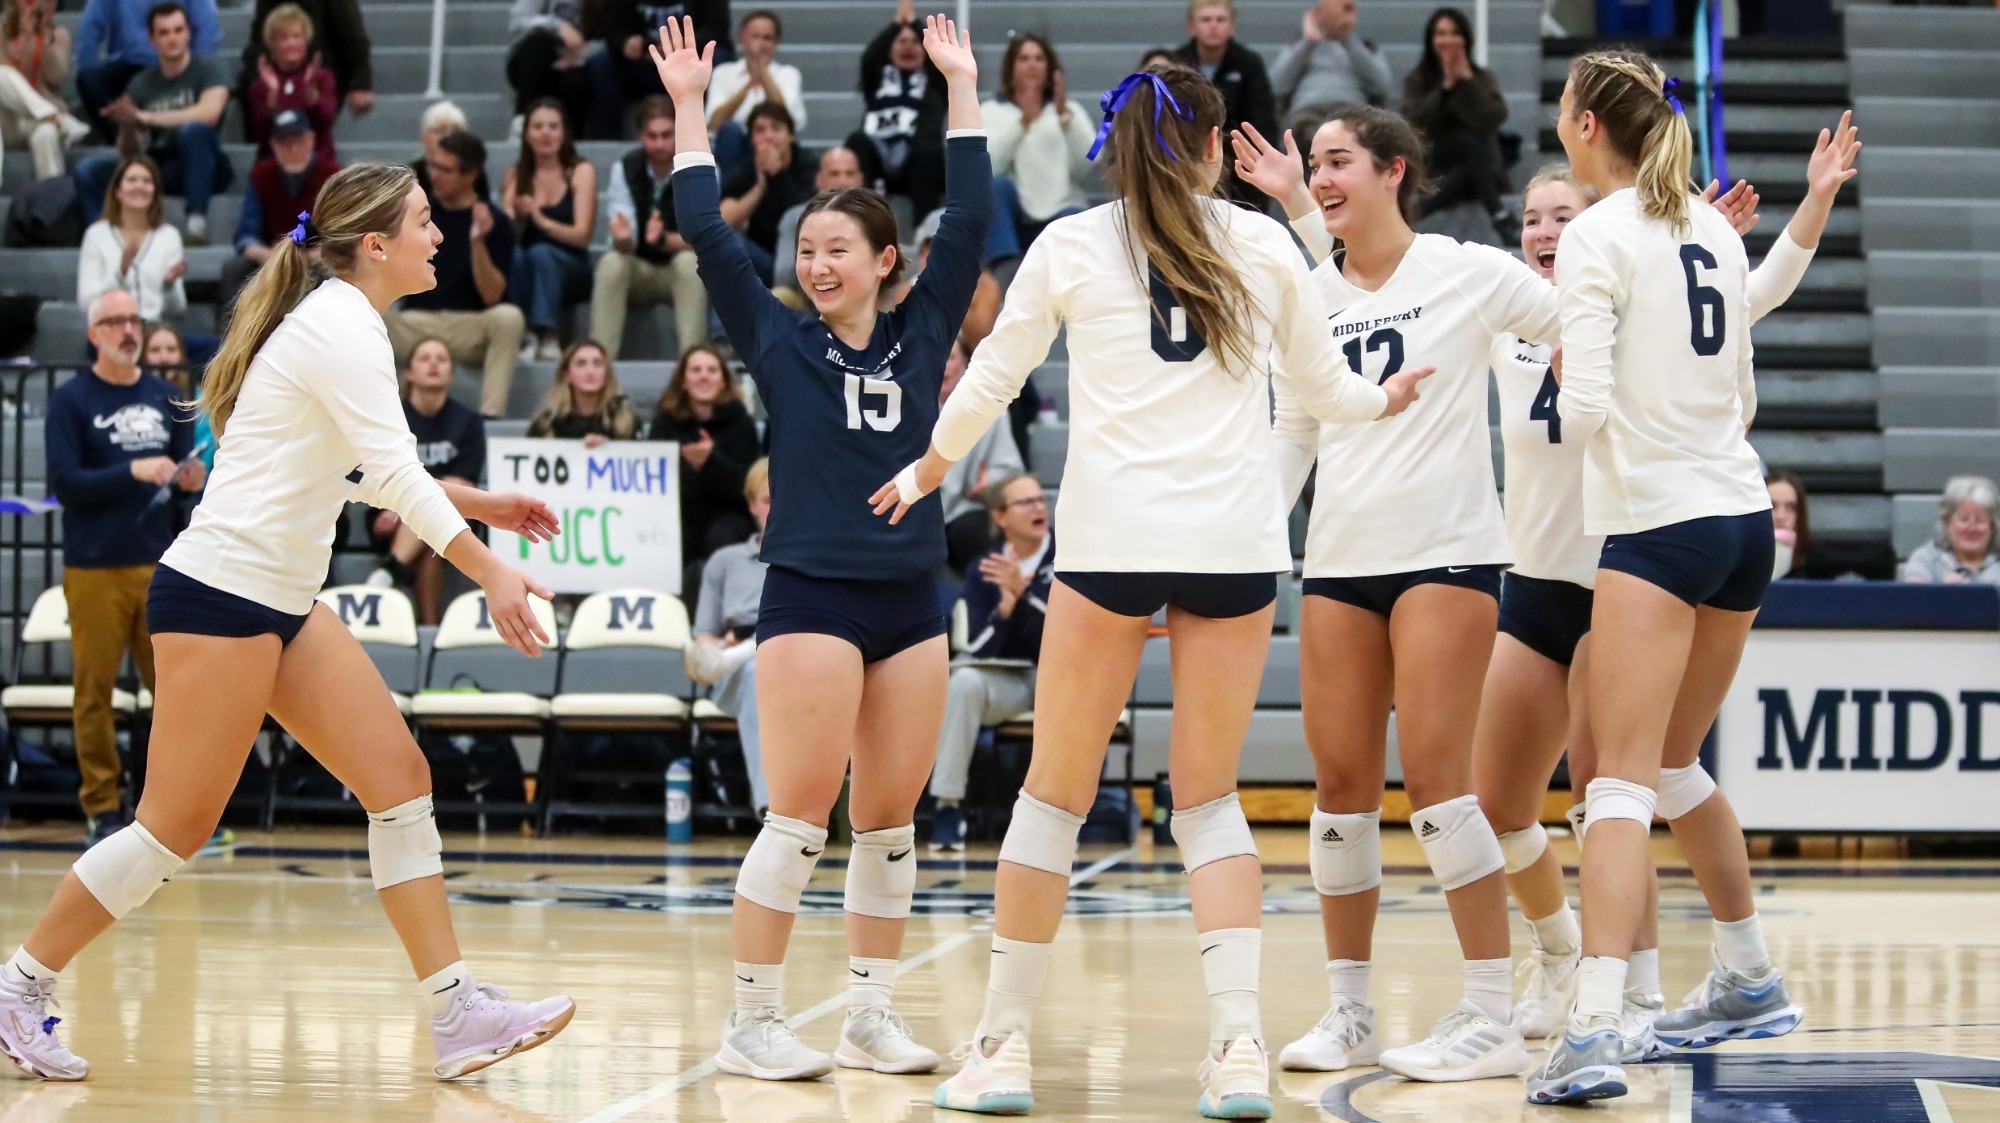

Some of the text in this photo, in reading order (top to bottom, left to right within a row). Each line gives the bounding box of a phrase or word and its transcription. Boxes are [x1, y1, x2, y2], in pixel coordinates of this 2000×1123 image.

[1679, 243, 1726, 357] 6
[1342, 327, 1405, 386] 12
[844, 372, 902, 432] 15
[1529, 363, 1562, 444] 4
[503, 454, 668, 496] TOO MUCH
[337, 594, 381, 627] M
[606, 597, 656, 630] M
[1756, 686, 2000, 772] MIDD
[1421, 827, 1440, 837] adidas
